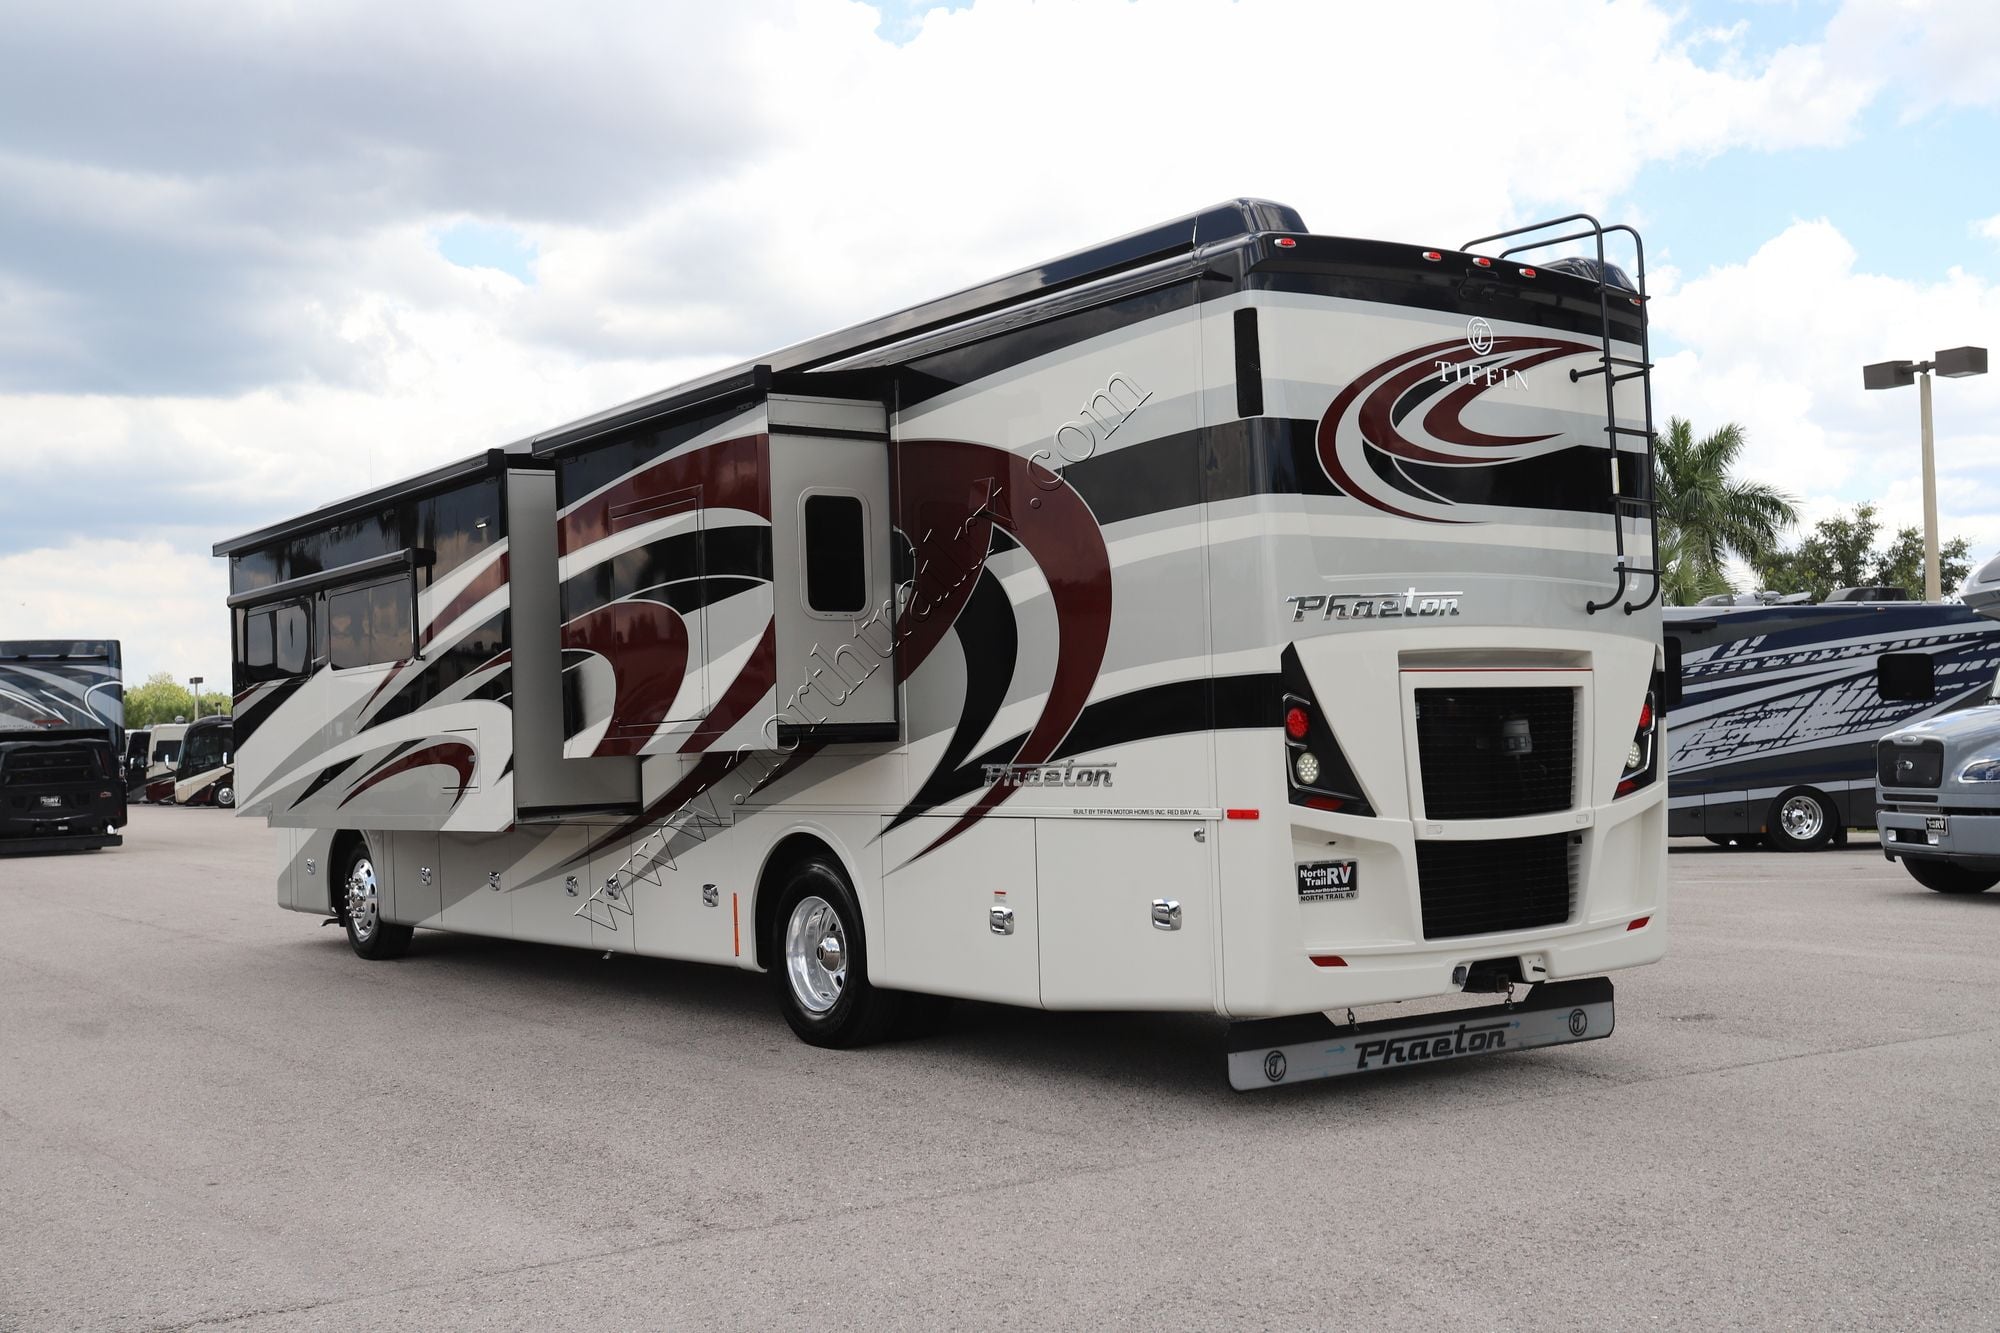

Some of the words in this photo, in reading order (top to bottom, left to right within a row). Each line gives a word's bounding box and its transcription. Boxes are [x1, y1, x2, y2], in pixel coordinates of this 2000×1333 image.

[1434, 360, 1529, 391] TIFFIN
[1286, 587, 1463, 622] Phaeton
[981, 760, 1117, 787] Phaeton
[1300, 868, 1326, 878] North
[1305, 877, 1326, 886] Trail
[1326, 866, 1352, 885] RV
[1300, 894, 1324, 902] NORTH
[1354, 1024, 1510, 1069] Phaeton
